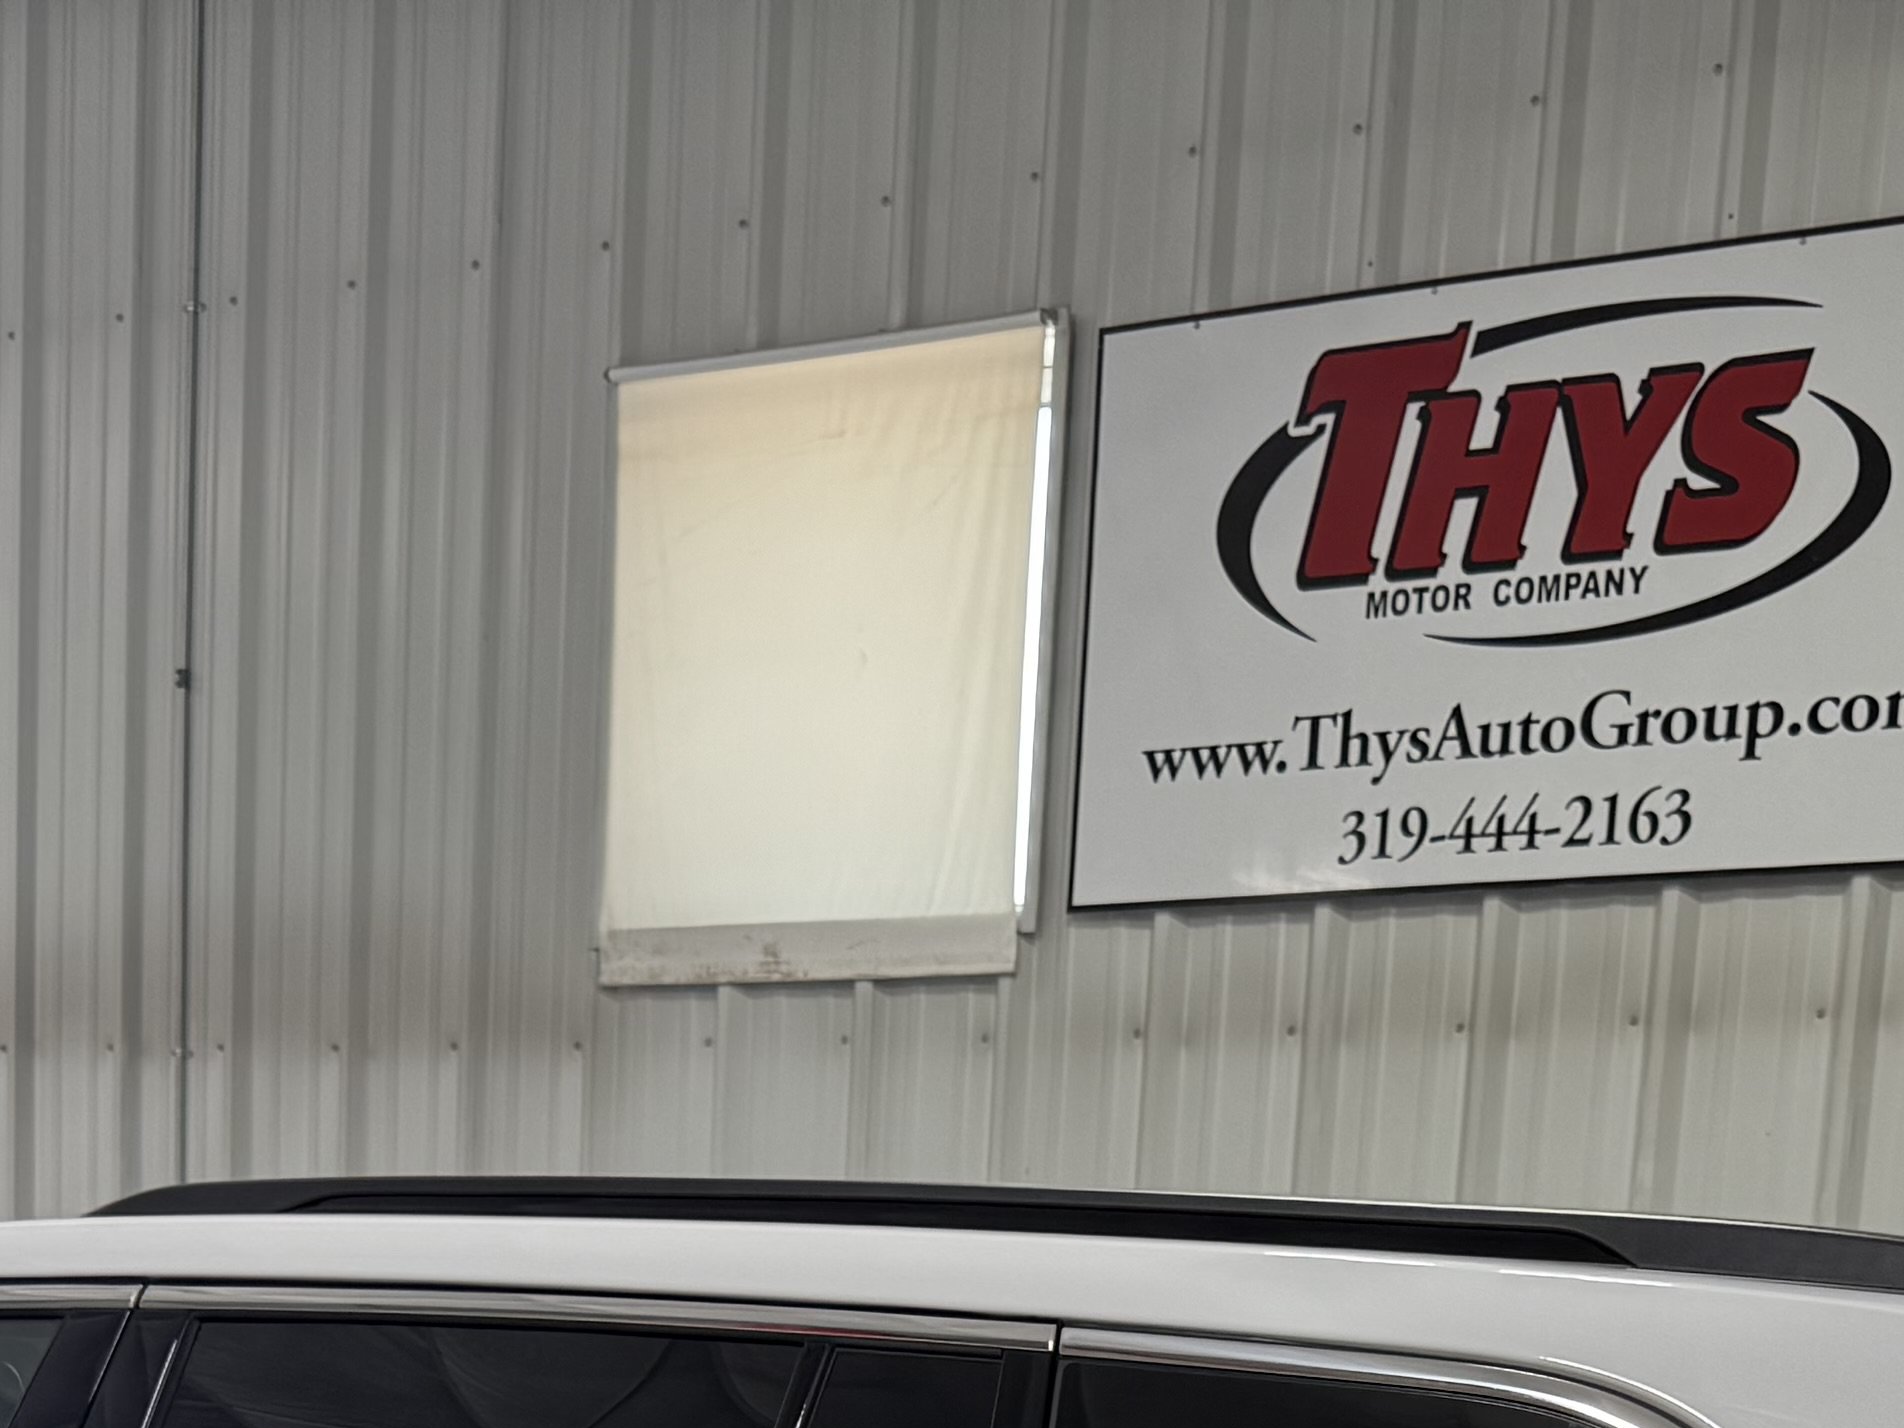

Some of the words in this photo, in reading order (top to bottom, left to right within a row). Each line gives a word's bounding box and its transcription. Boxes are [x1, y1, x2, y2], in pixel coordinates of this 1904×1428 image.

[1294, 321, 1816, 590] THYS
[1364, 582, 1473, 620] MOTOR
[1493, 565, 1649, 608] COMPANY
[1337, 786, 1694, 866] 319-444-2163
